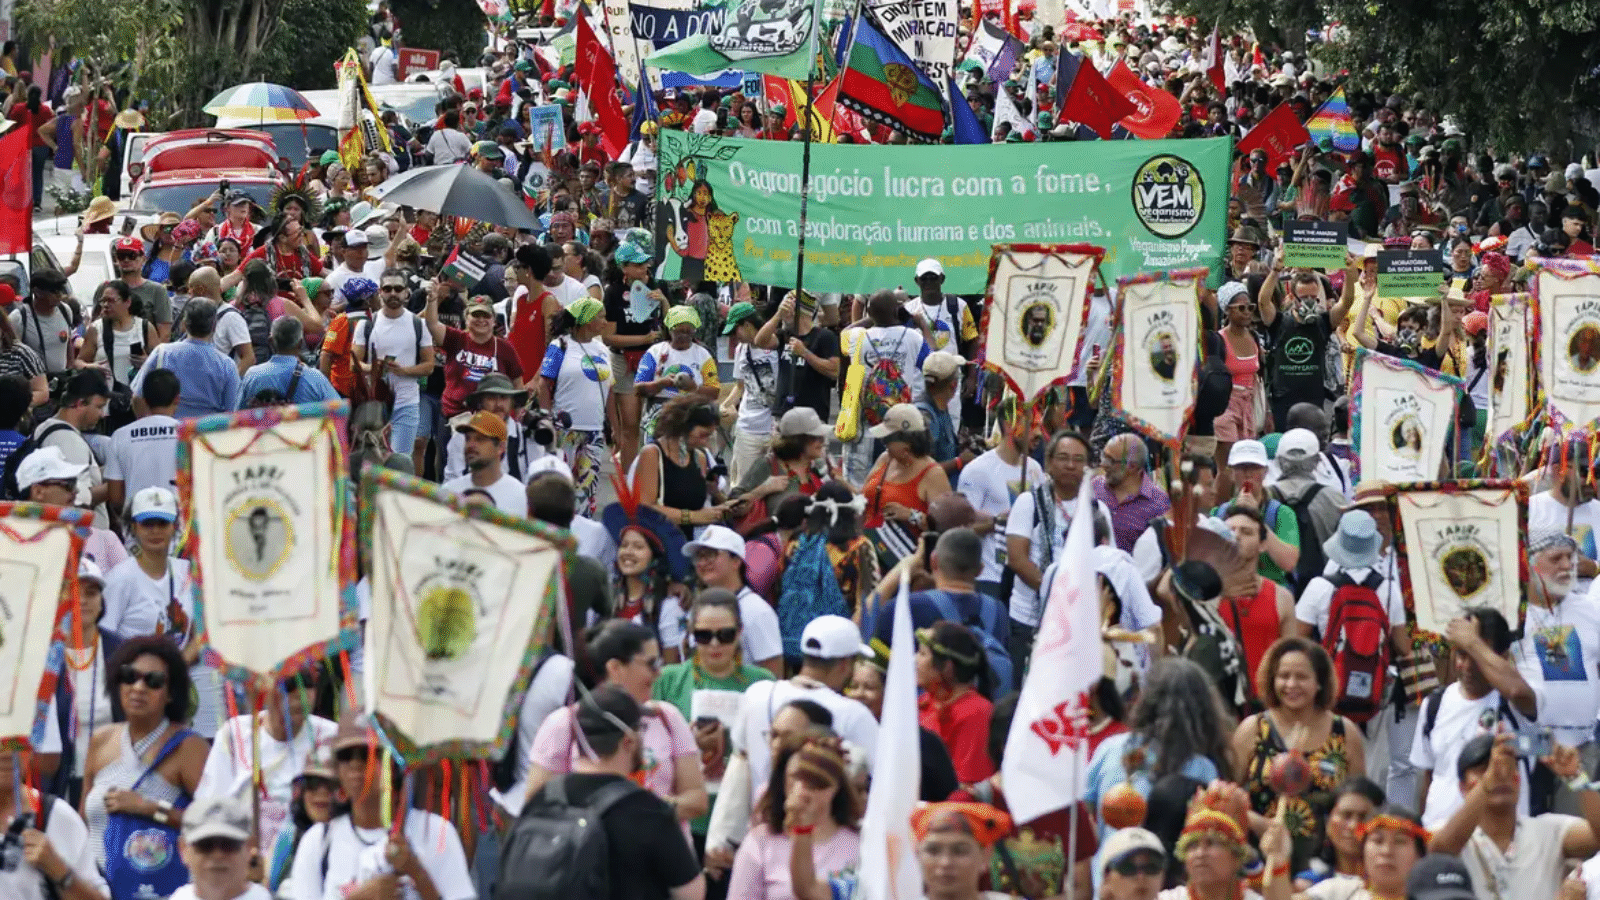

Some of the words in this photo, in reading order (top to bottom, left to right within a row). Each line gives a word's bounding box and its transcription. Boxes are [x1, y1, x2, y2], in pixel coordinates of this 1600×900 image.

[912, 2, 947, 17] TEM
[663, 15, 679, 39] A
[729, 161, 746, 187] O
[747, 168, 874, 202] agronegócio
[884, 166, 945, 198] lucra
[952, 176, 1003, 197] com
[1012, 175, 1026, 195] a
[1137, 183, 1192, 209] VEM
[1141, 206, 1195, 220] veganismo
[746, 215, 782, 236] com
[786, 217, 799, 237] a
[805, 215, 892, 247] exploração
[897, 218, 963, 242] humana
[969, 223, 978, 240] e
[983, 217, 1016, 240] dos
[130, 426, 175, 439] UBUNT
[1437, 524, 1480, 540] TAPIRI
